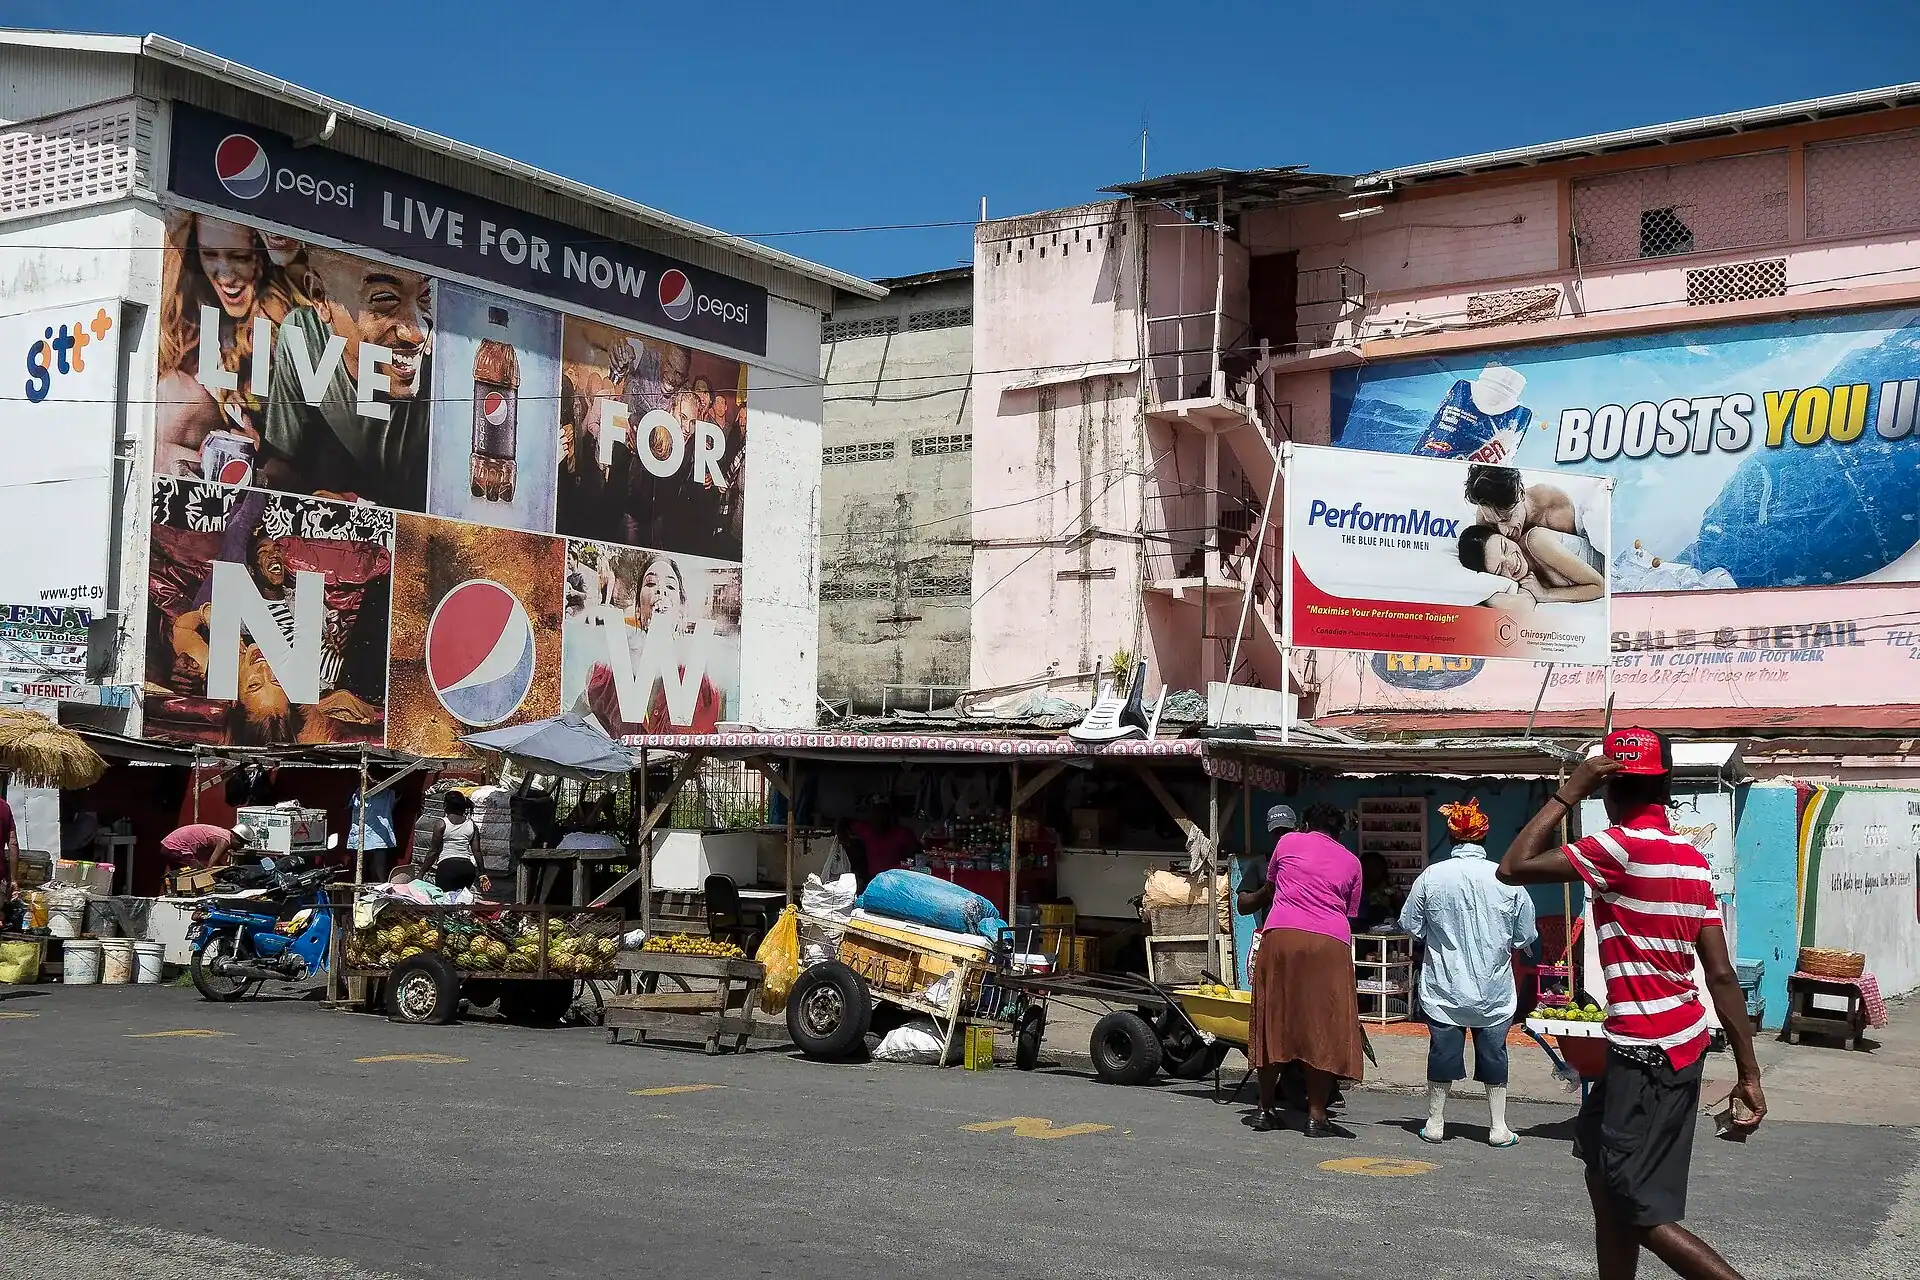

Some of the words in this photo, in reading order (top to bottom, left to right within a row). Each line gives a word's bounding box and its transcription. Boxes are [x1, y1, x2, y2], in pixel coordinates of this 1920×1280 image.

[275, 168, 354, 208] pepsi
[382, 191, 464, 248] LIVE
[480, 220, 552, 274] FOR
[563, 246, 646, 298] NOW
[697, 294, 748, 325] pepsi
[198, 304, 393, 421] LIVE
[1554, 394, 1754, 464] BOOSTS
[1763, 383, 1870, 447] YOU
[1876, 378, 1920, 441] U
[599, 399, 729, 488] FOR
[1308, 499, 1460, 539] PerformMax
[1341, 534, 1356, 545] THE
[1358, 537, 1377, 546] BLUE
[1379, 538, 1395, 548] PILL
[1397, 539, 1411, 549] FOR
[1413, 541, 1430, 551] MEN
[40, 584, 104, 600] www.gtt.gy
[1352, 608, 1370, 617] Your
[1371, 609, 1424, 620] Performance
[1650, 654, 1665, 667] IN
[1669, 652, 1733, 666] CLOTHING
[1737, 651, 1757, 663] AND
[1549, 671, 1584, 688] Best
[1586, 668, 1648, 685] Whlesale
[1661, 666, 1700, 684] Retail
[1700, 668, 1743, 683] Prices
